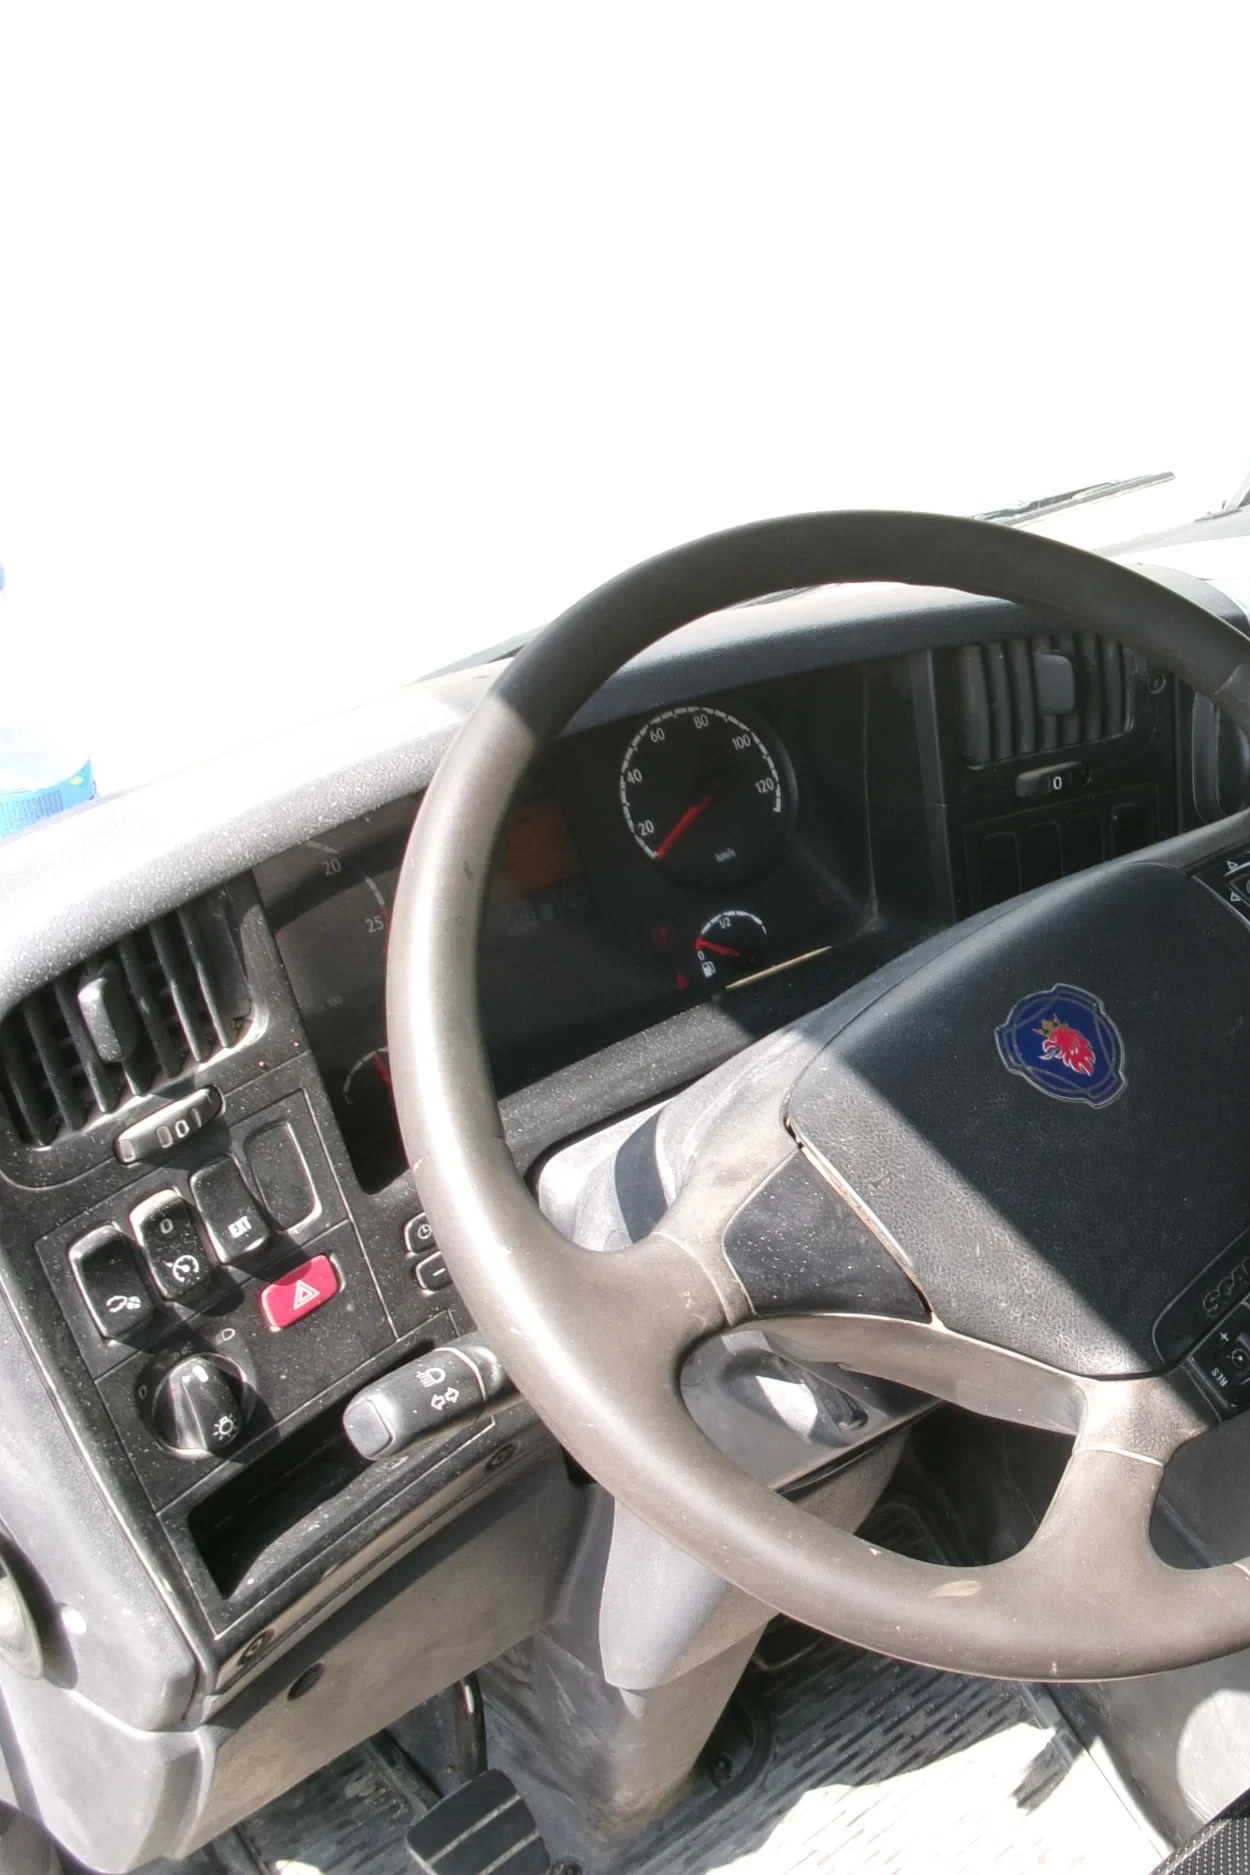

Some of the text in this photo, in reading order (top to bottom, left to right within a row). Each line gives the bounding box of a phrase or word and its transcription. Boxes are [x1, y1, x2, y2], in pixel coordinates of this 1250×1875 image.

[693, 713, 709, 729] 80
[650, 727, 666, 743] 60
[732, 734, 751, 750] 100
[627, 768, 643, 783] 40
[755, 777, 774, 793] 120
[638, 820, 654, 836] 20
[322, 858, 341, 876] 20
[365, 915, 384, 933] 25
[1211, 1367, 1229, 1387] RES
